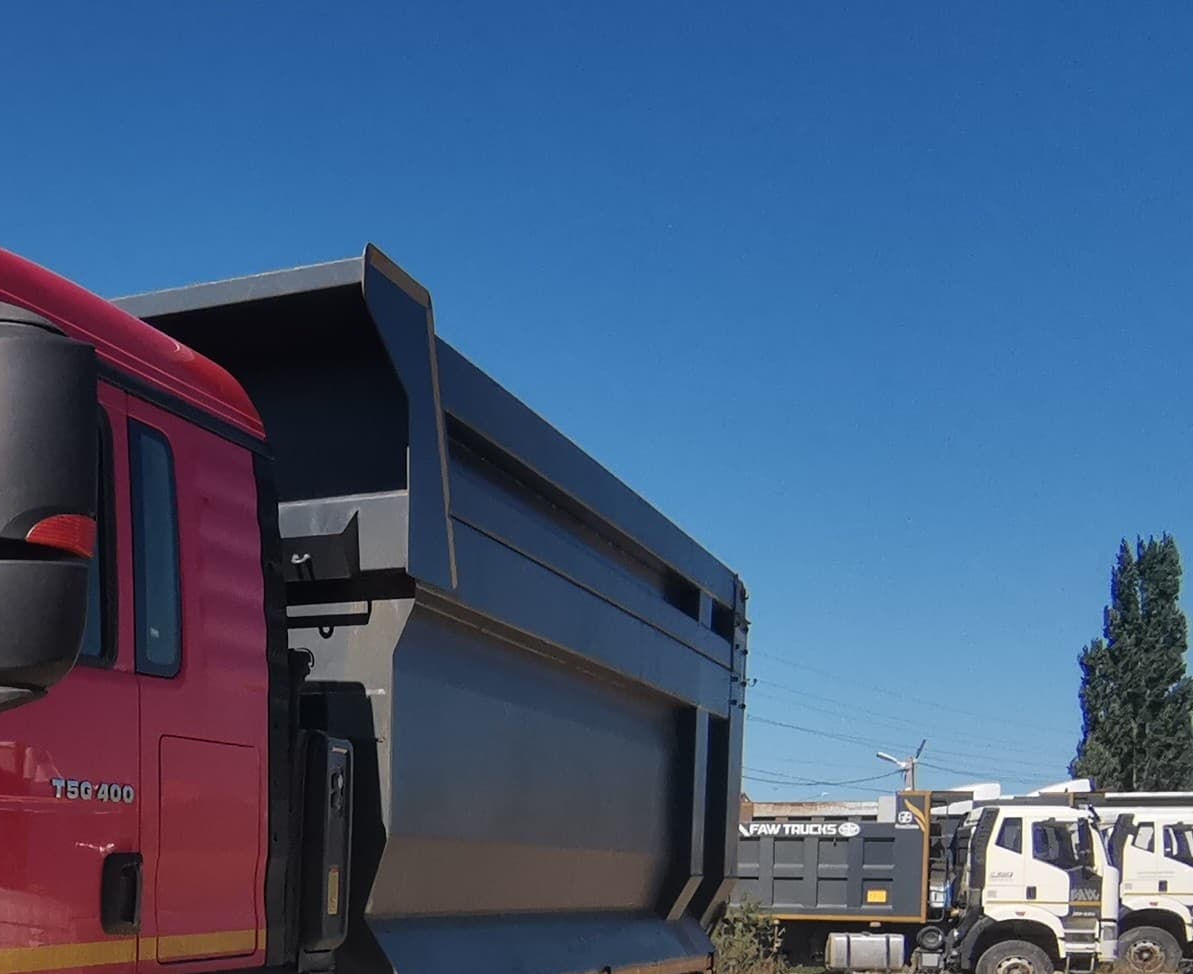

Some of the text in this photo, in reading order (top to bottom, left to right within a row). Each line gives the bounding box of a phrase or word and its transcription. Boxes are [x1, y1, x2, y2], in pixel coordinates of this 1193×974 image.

[51, 778, 135, 804] T5G 400
[749, 823, 838, 836] FAW TRUCKS
